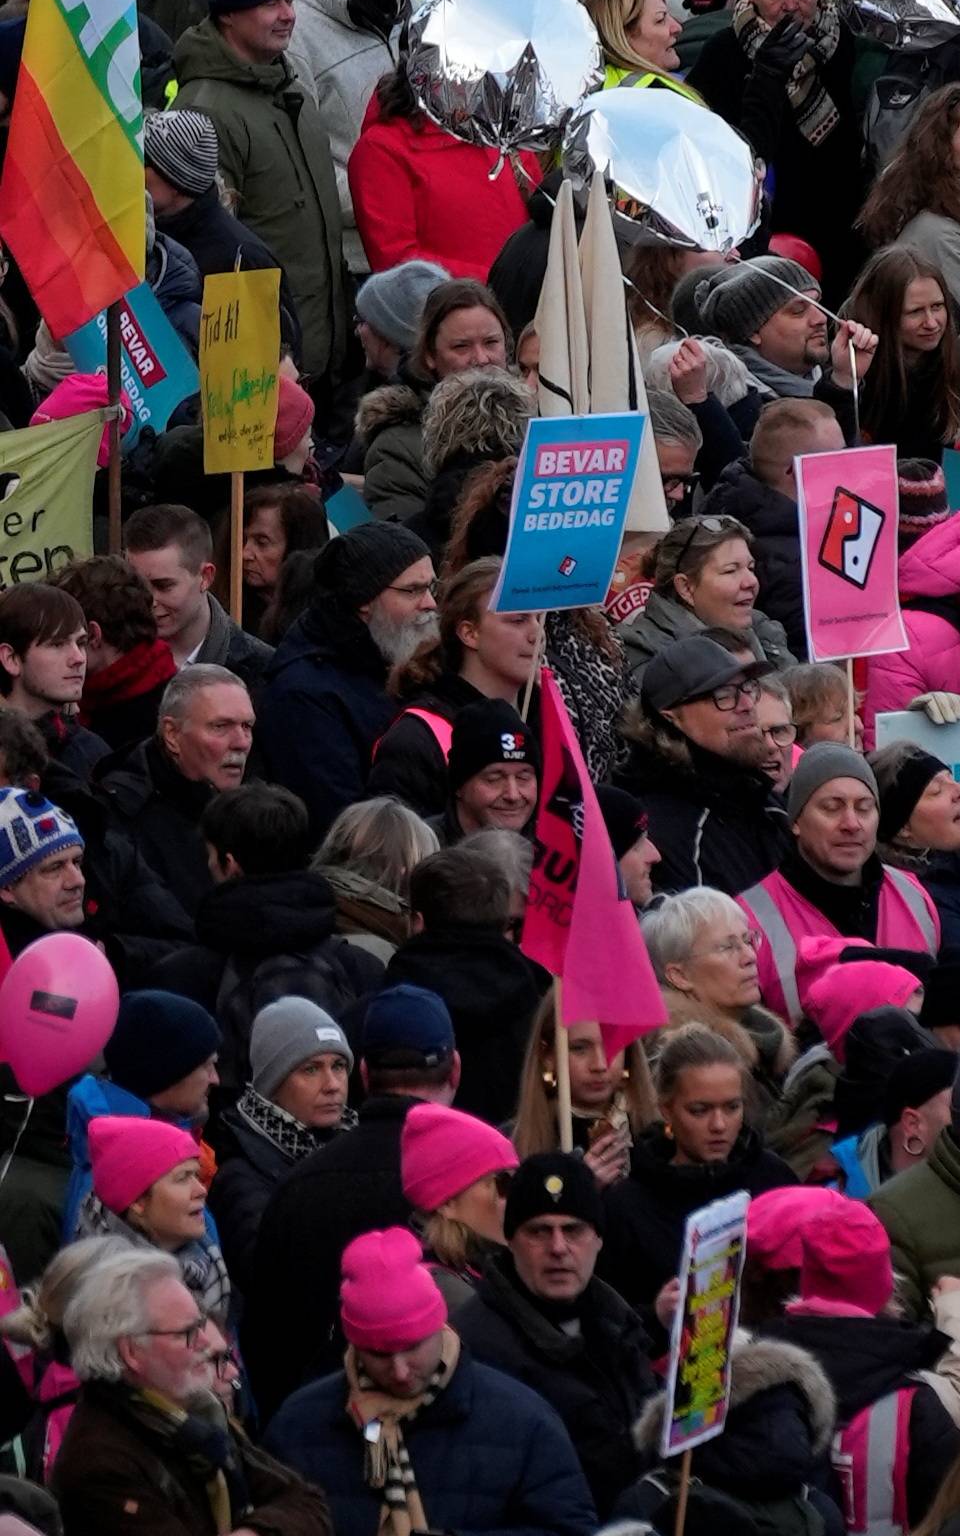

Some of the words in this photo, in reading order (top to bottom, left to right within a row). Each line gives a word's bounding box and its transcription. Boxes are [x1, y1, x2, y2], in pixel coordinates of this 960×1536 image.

[538, 447, 625, 476] BEVAR
[528, 478, 624, 509] STORE
[513, 509, 616, 533] BEDEDAG
